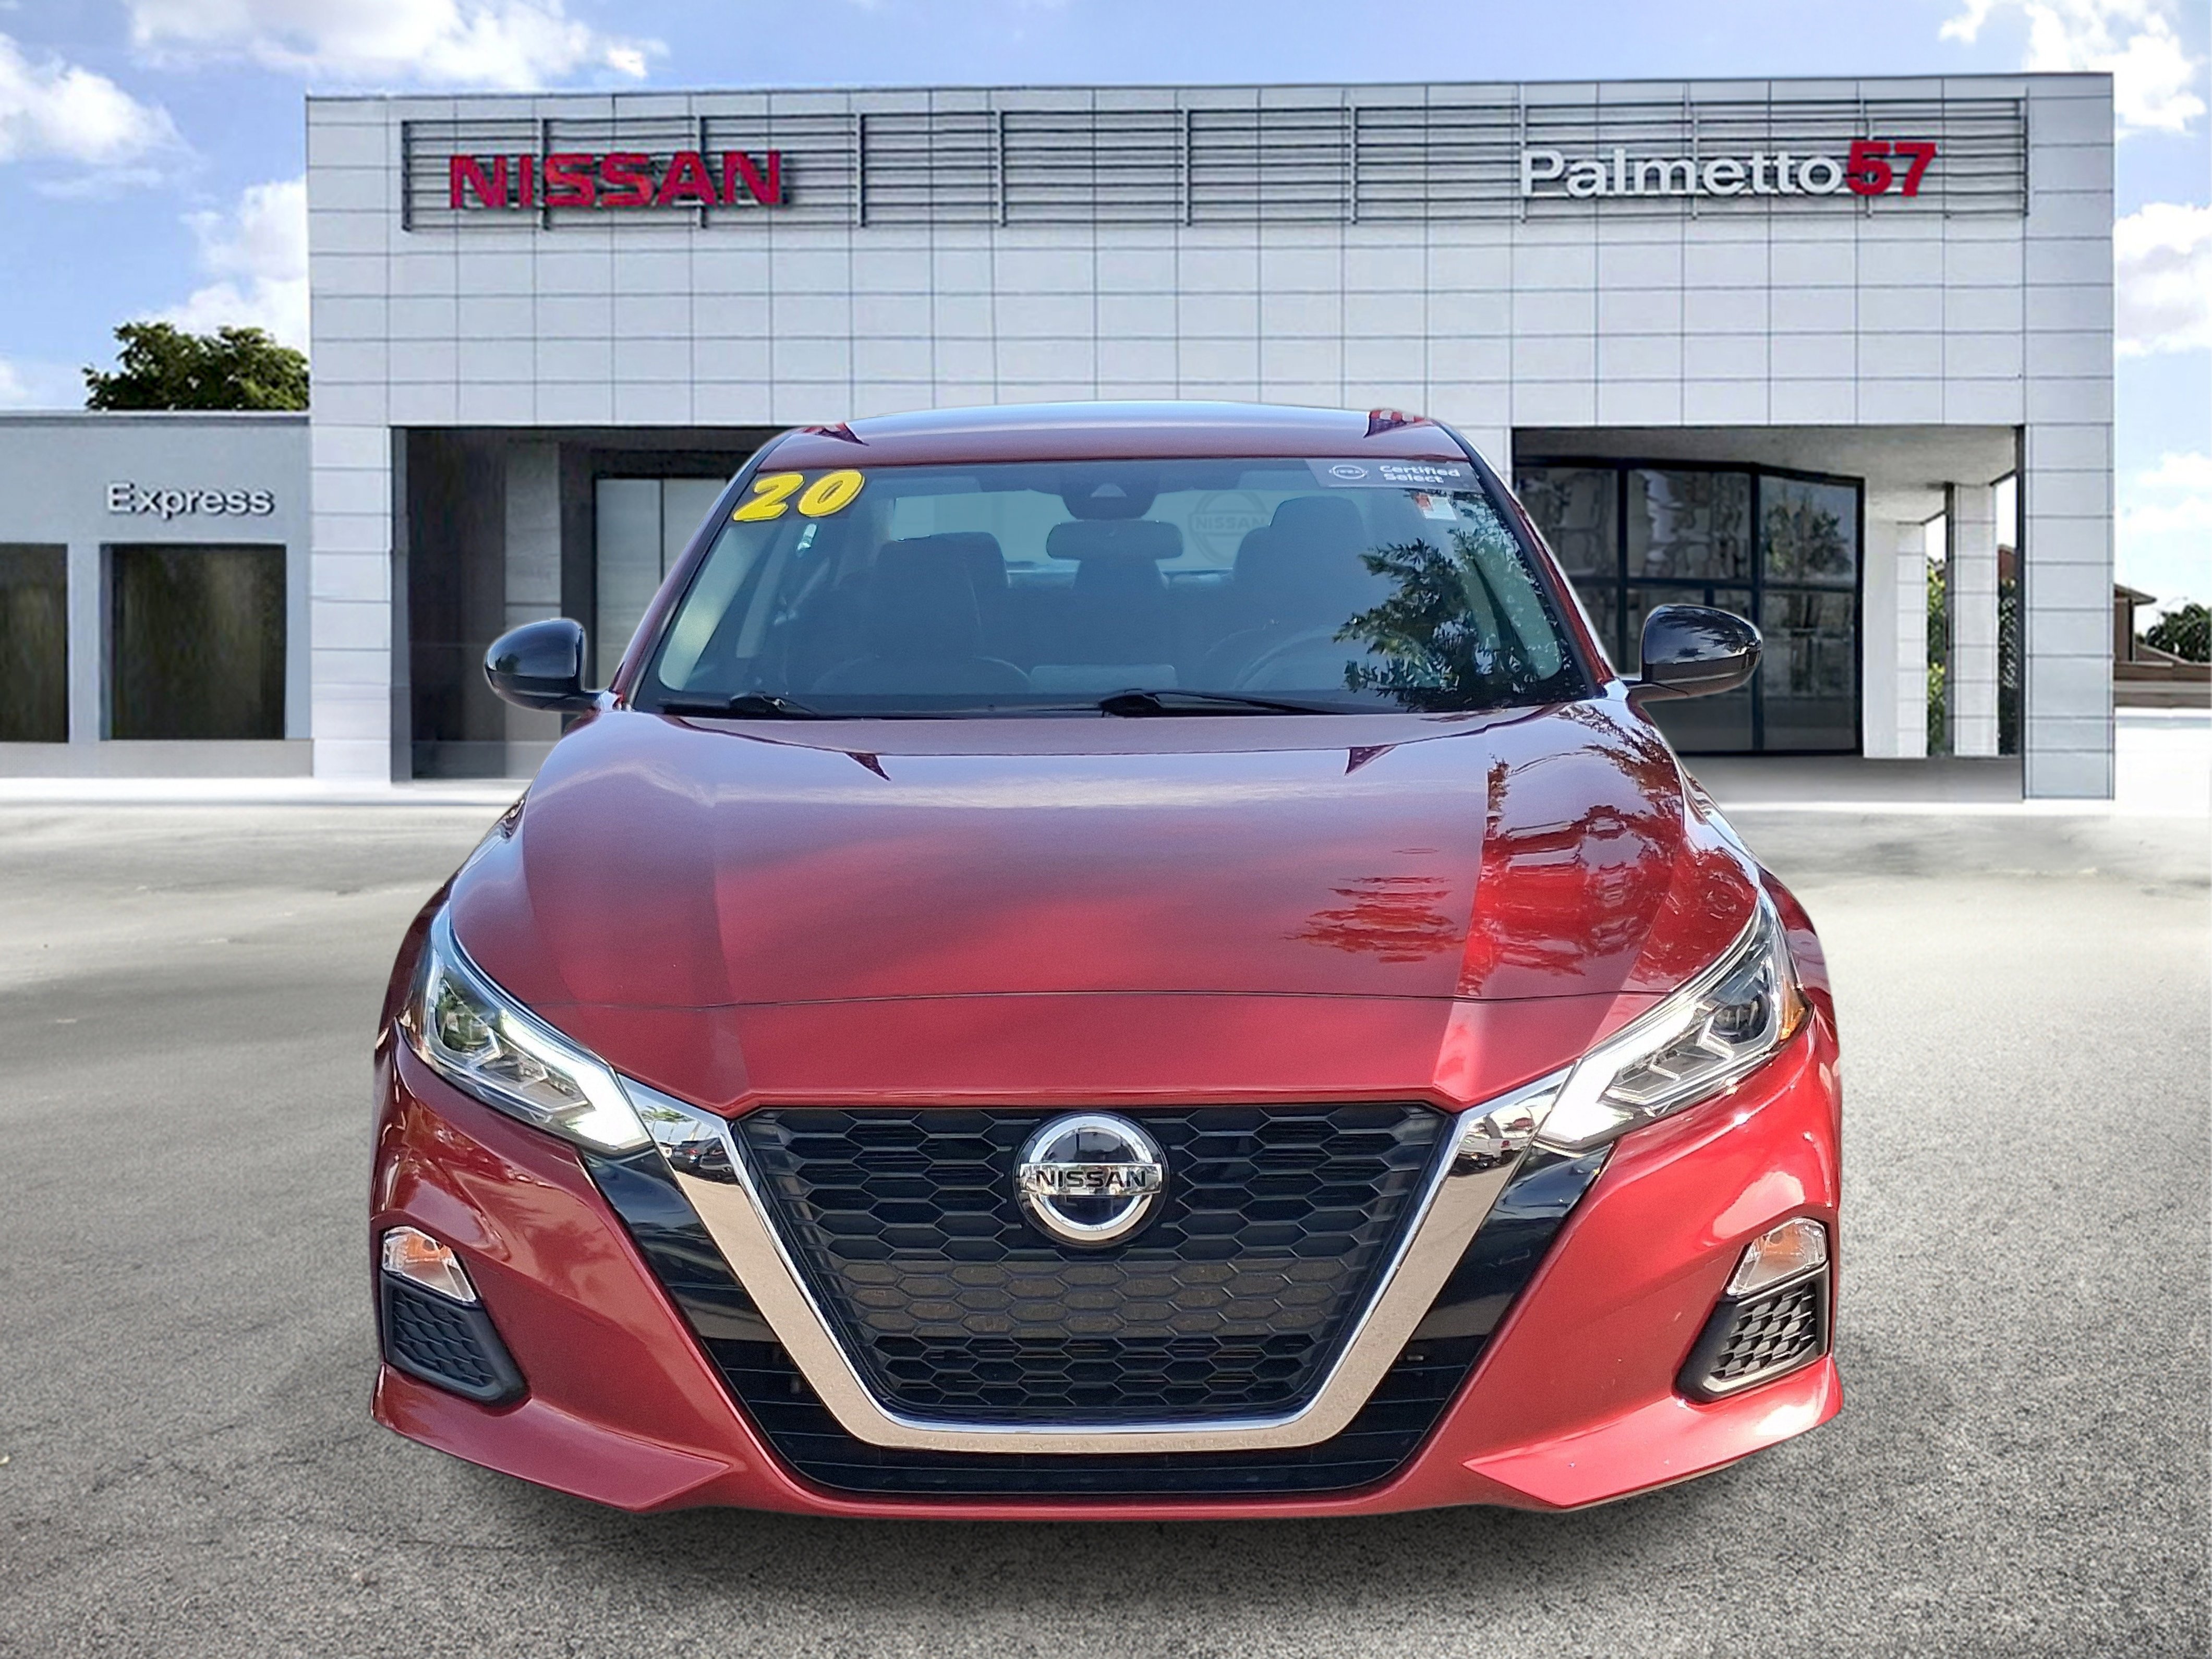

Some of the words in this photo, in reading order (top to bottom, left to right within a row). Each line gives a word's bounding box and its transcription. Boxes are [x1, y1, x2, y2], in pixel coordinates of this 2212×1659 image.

[450, 151, 781, 209] NISSAN
[1380, 465, 1460, 477] Certified
[1383, 473, 1444, 483] Select
[107, 482, 274, 520] Express
[733, 469, 864, 521] 20
[1036, 1170, 1146, 1188] NISSAN
